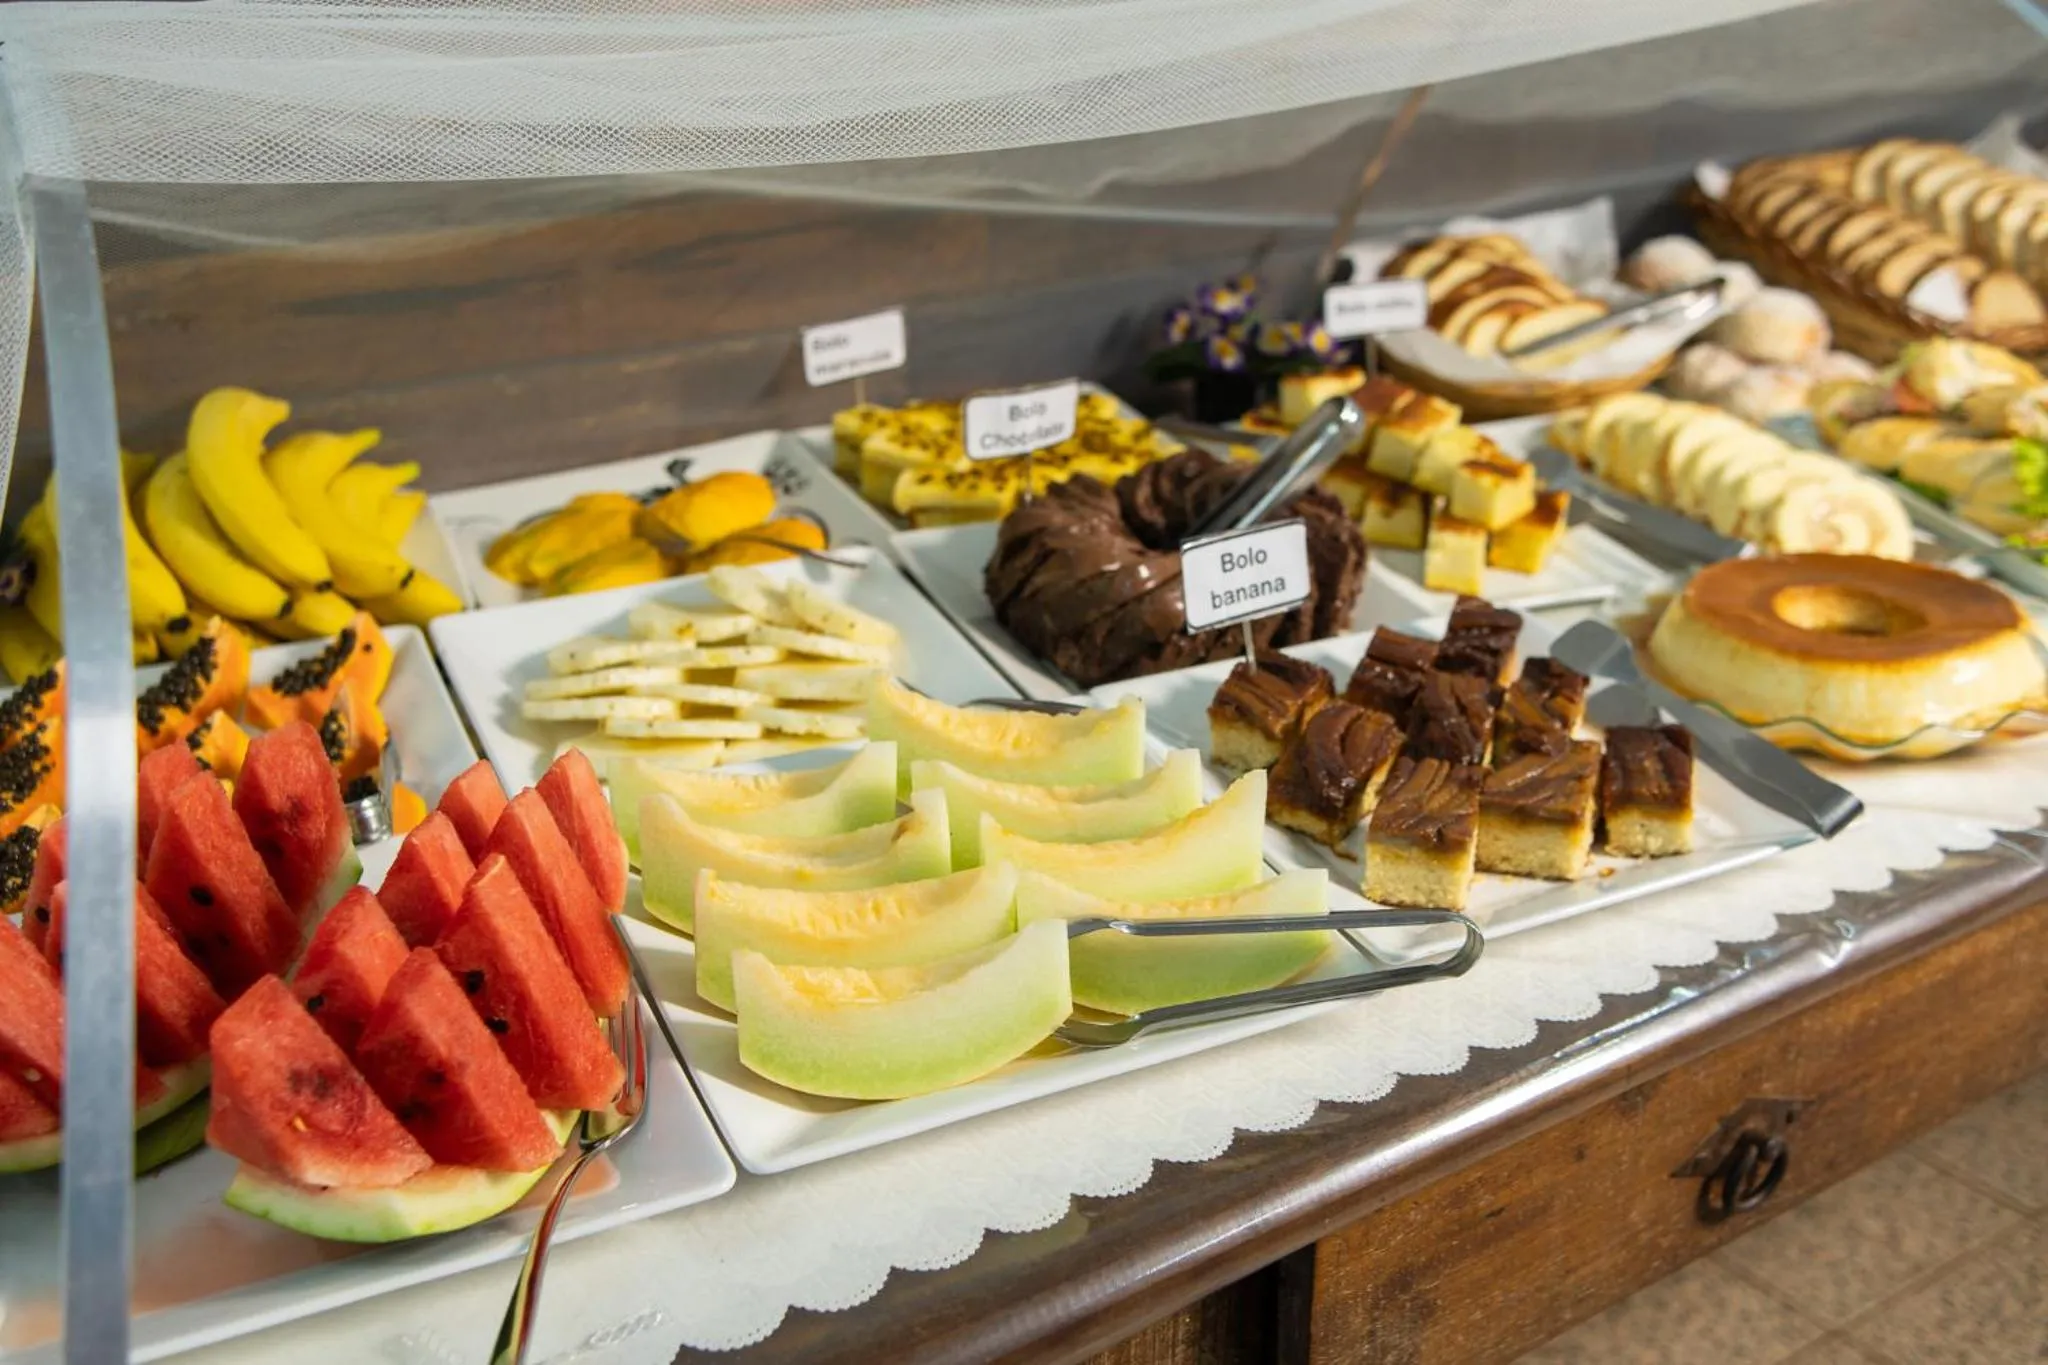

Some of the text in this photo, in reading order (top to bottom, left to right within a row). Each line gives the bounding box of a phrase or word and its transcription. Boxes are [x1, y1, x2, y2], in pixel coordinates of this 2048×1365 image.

[1008, 402, 1048, 422] Bolo
[1220, 546, 1268, 573] Bolo
[1210, 576, 1287, 609] banana
